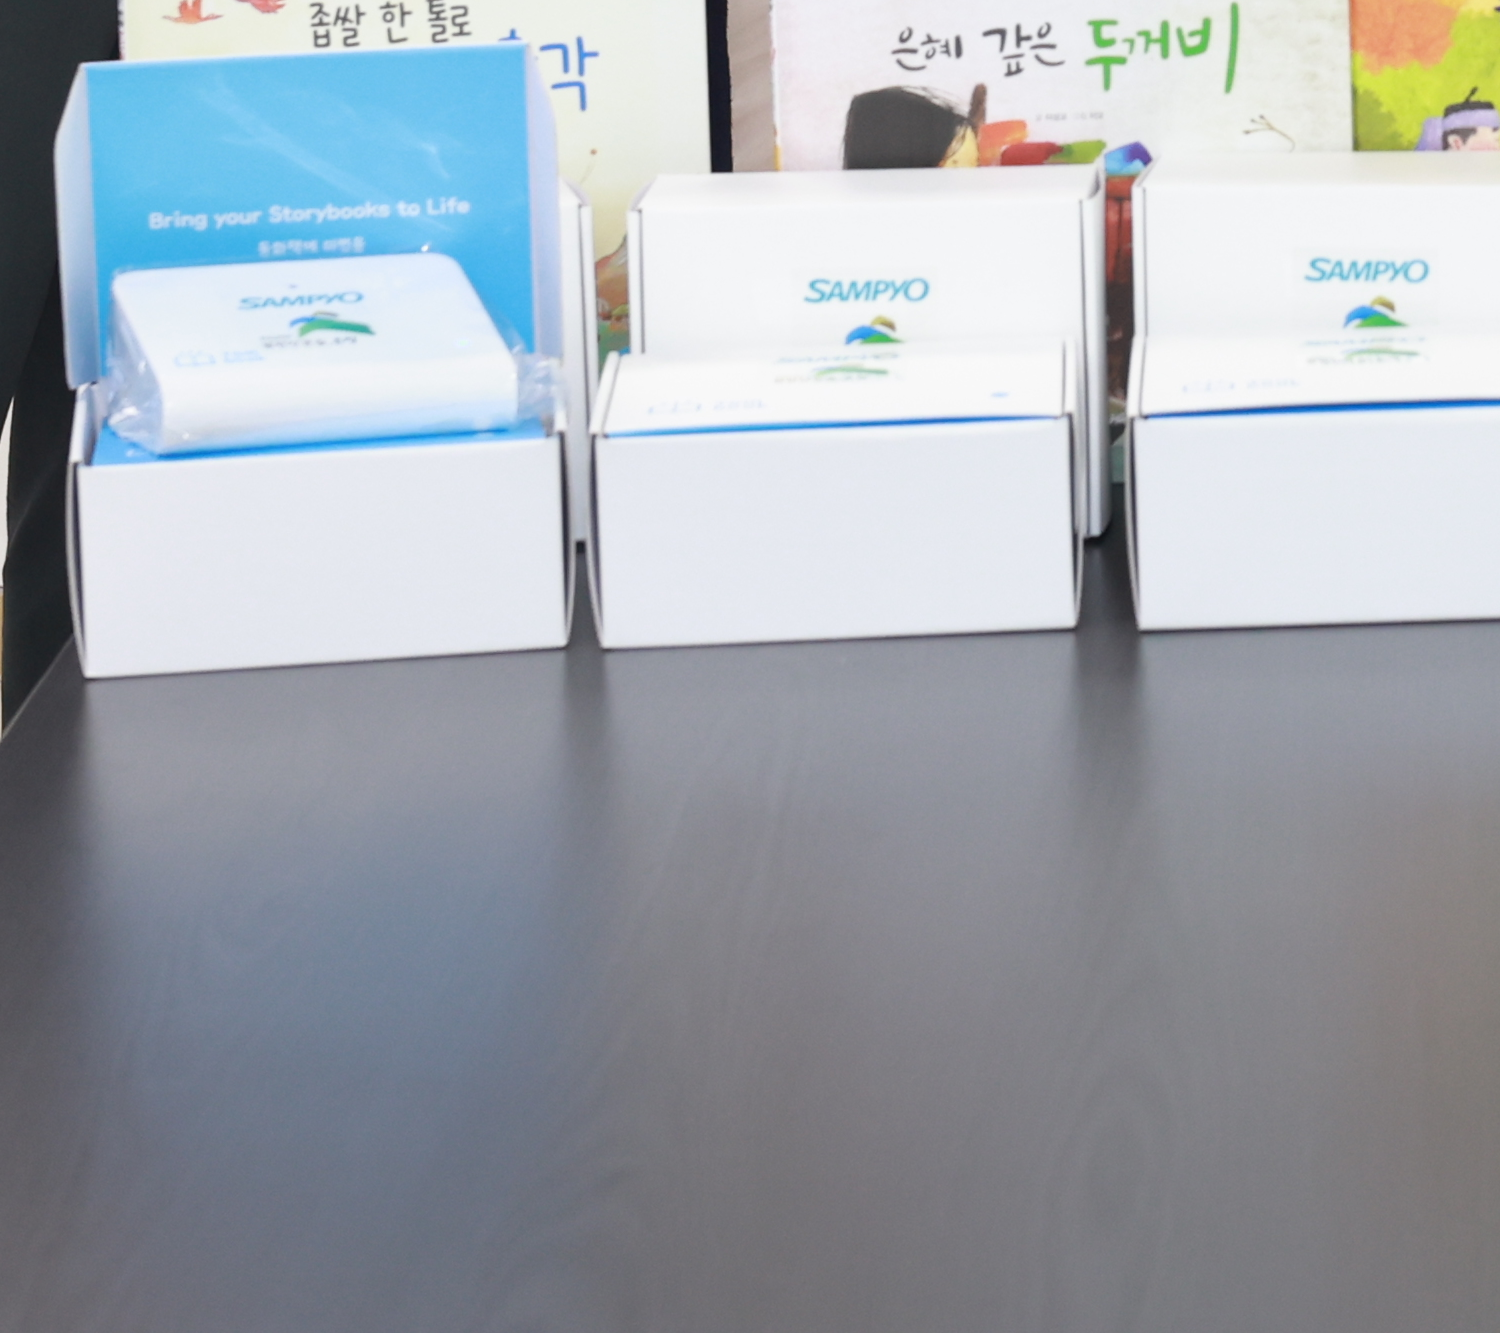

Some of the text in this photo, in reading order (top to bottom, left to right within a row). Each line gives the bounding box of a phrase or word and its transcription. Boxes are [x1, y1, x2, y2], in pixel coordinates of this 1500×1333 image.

[308, 1, 367, 49] 좁쌀
[378, 0, 414, 45] 한
[890, 1, 1241, 94] 은혜 갚은 두꺼비
[148, 197, 471, 231] Bring your Storybooks to Life
[1304, 257, 1430, 284] SAMPYO
[238, 290, 364, 311] SAMPYO
[803, 277, 931, 304] SAMPYO
